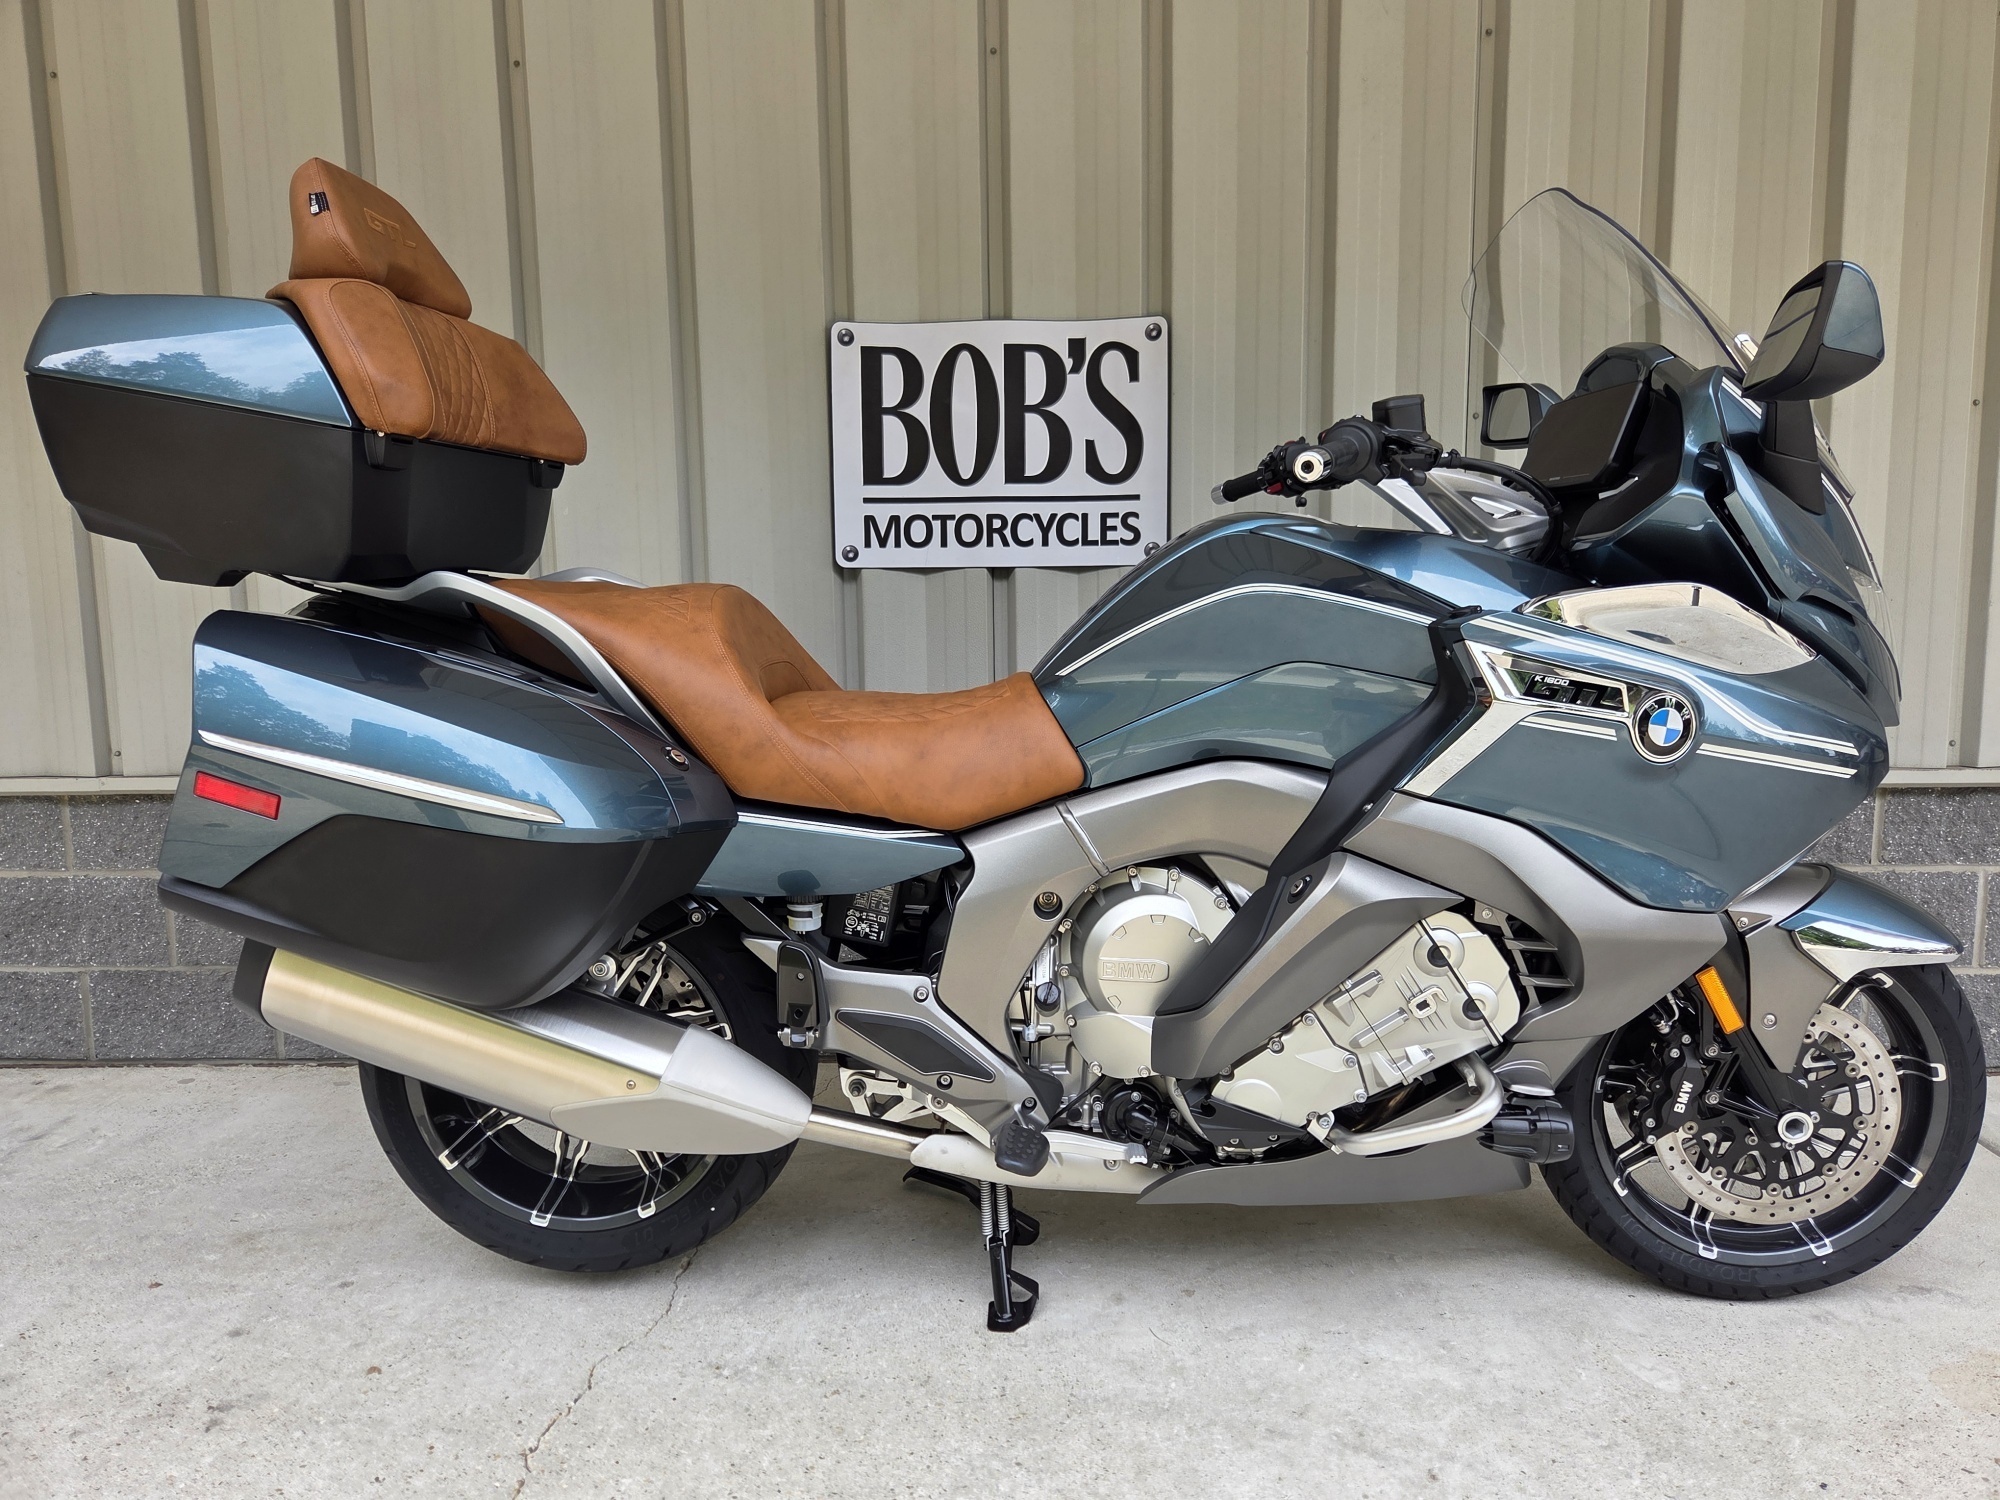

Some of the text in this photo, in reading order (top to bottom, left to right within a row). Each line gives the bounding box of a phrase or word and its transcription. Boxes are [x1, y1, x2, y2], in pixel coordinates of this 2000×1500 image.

[363, 207, 417, 249] GTL
[860, 336, 1144, 488] BOB'S
[863, 511, 1142, 550] MOTORCYCLES
[1534, 674, 1570, 687] K 1600
[1645, 697, 1692, 721] BMW
[1101, 960, 1157, 981] BMW
[1673, 1080, 1694, 1114] BMW
[660, 1156, 738, 1232] OADTEC
